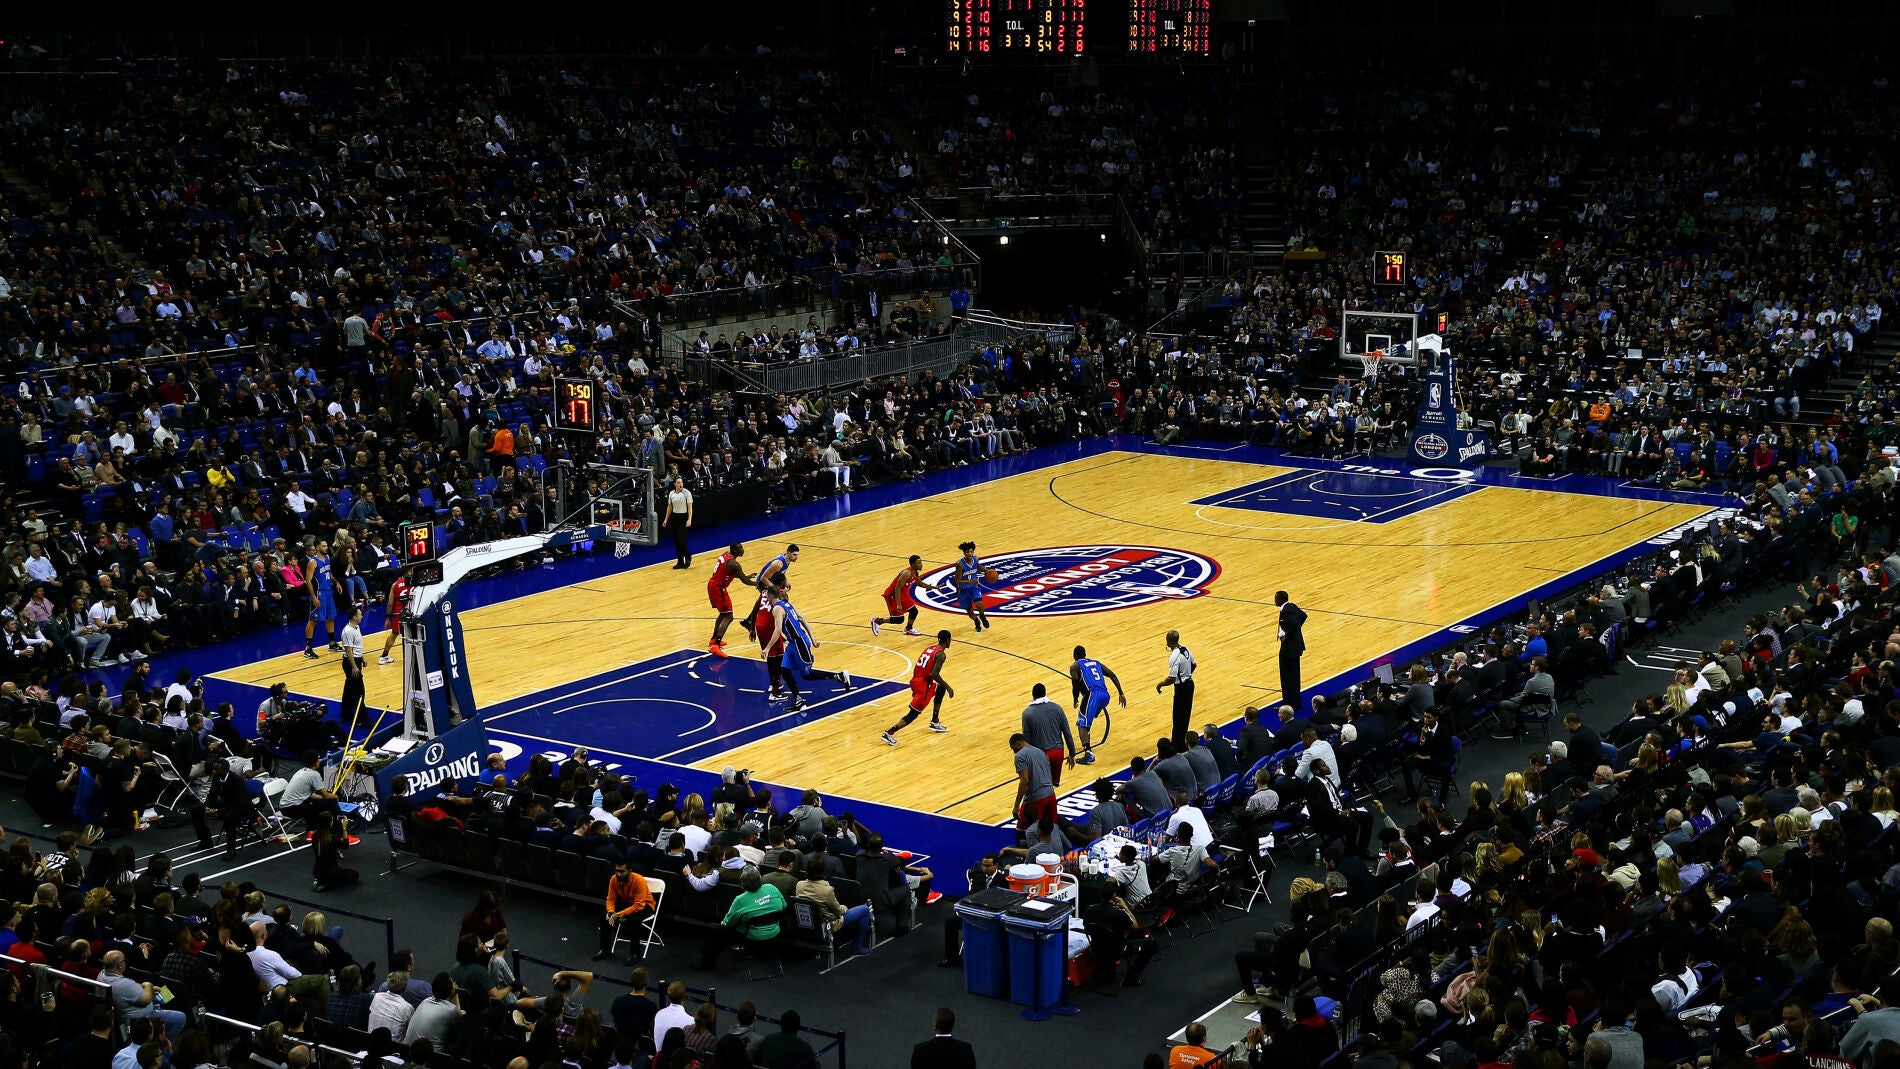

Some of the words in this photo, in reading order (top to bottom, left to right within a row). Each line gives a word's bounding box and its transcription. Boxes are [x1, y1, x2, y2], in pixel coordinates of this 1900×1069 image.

[953, 11, 960, 22] 9
[966, 11, 972, 23] 2
[980, 11, 990, 23] 10
[1046, 10, 1052, 23] 8
[950, 25, 960, 37] 10
[966, 25, 972, 37] 3
[980, 26, 990, 37] 14
[1006, 20, 1024, 30] T.O.L.
[1039, 25, 1052, 37] 31
[1058, 25, 1065, 37] 2
[1076, 25, 1084, 37] 2
[950, 40, 960, 51] 14
[980, 40, 990, 51] 16
[1005, 35, 1011, 47] 3
[1024, 35, 1031, 47] 3
[1038, 40, 1052, 51] 54
[1058, 40, 1065, 51] 2
[1076, 40, 1084, 51] 8
[1385, 255, 1402, 265] 7:50
[1386, 265, 1400, 281] 17
[569, 384, 591, 399] 7:50
[571, 400, 590, 424] 17
[1459, 440, 1485, 463] SPALDING
[1341, 464, 1401, 475] The
[411, 528, 428, 541] 7:50
[411, 541, 426, 556] 17
[465, 545, 492, 556] SPALDING
[986, 558, 1131, 600] LONDON
[1063, 566, 1142, 590] GLOBAL
[999, 589, 1072, 612] GAMES
[917, 653, 931, 668] 31
[1090, 668, 1101, 682] 5
[404, 751, 480, 797] PALDING
